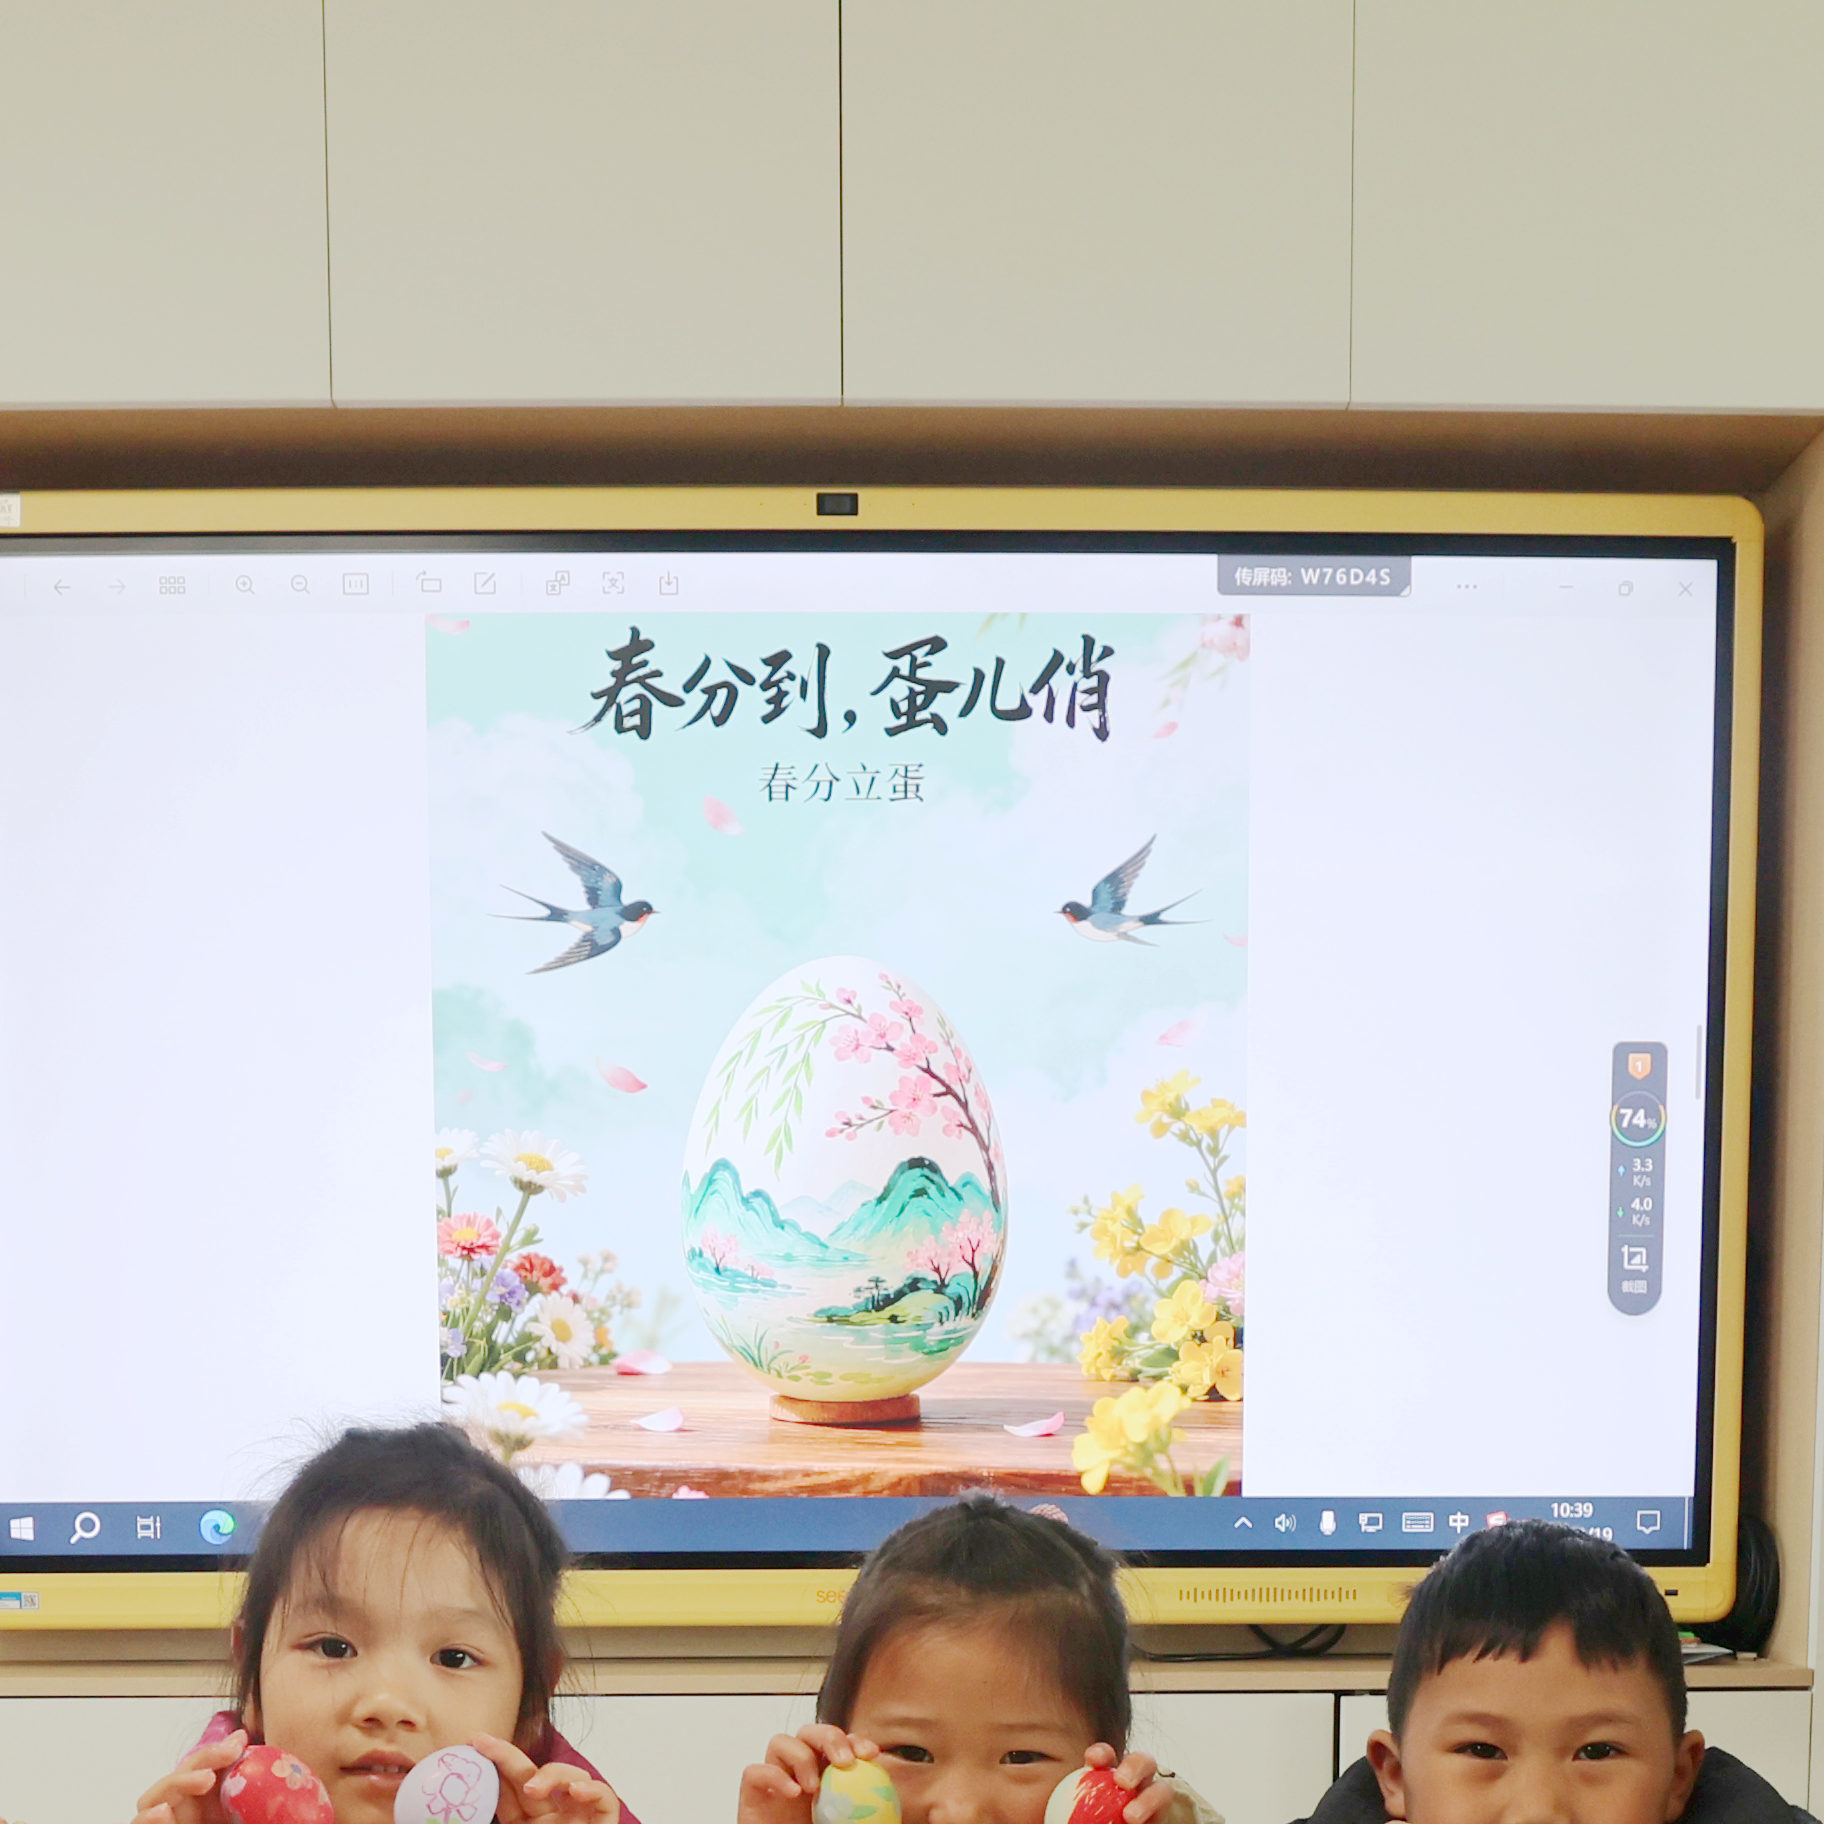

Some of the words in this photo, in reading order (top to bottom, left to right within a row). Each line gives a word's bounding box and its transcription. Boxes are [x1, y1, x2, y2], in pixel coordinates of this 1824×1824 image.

[1235, 566, 1293, 587] 传屏码:
[1301, 567, 1392, 586] W76D4S
[759, 762, 926, 803] 春分立蛋
[1619, 1107, 1658, 1130] 74%
[1632, 1158, 1654, 1173] 3.3
[1633, 1174, 1652, 1188] K/s
[1631, 1197, 1654, 1212] 4.0
[1632, 1213, 1651, 1227] K/s
[1551, 1502, 1594, 1519] 10:39
